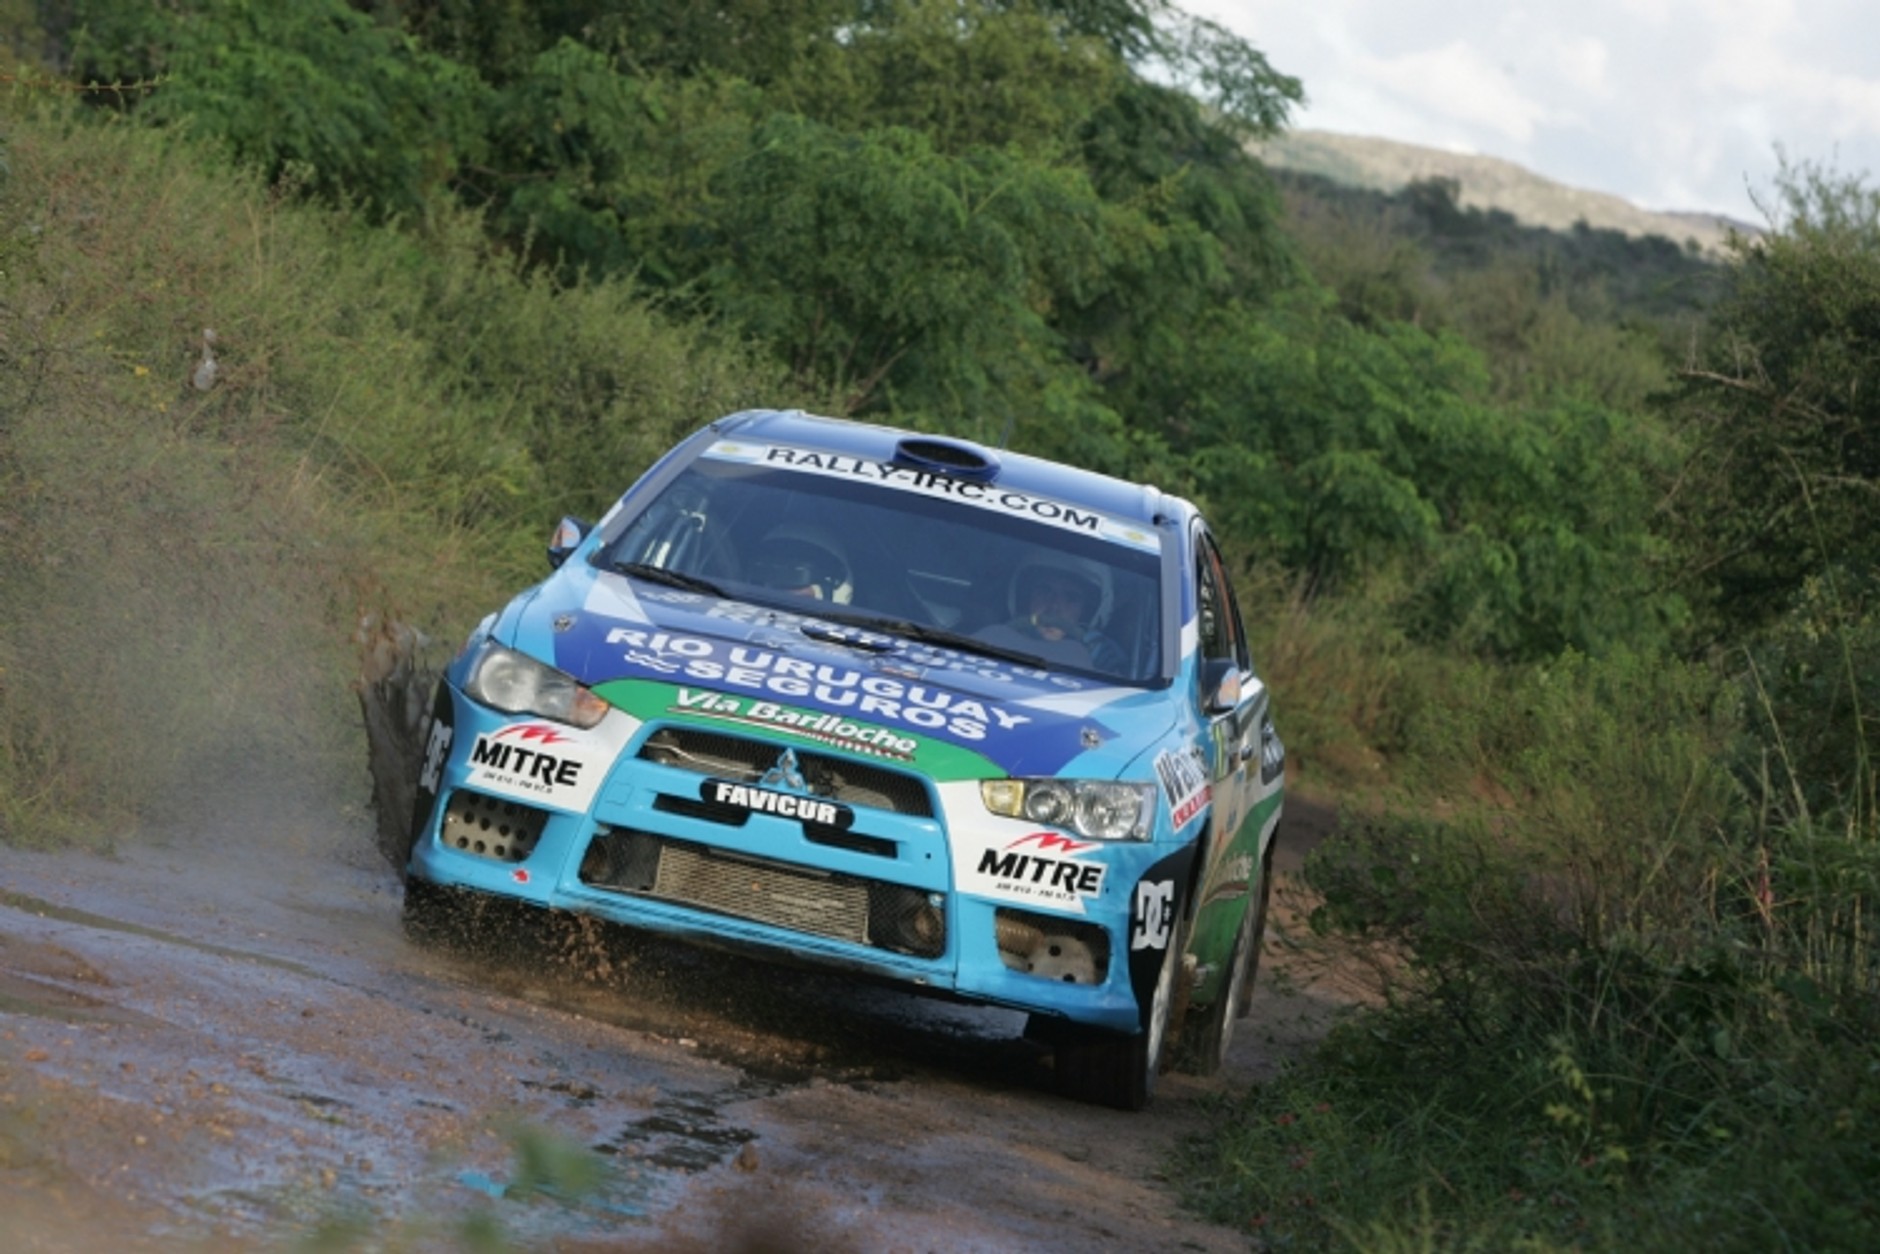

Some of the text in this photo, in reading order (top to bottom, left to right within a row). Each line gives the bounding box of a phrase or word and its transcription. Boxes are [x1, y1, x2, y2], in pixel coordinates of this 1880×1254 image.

[766, 447, 1101, 531] RALLY-IRC.COM
[605, 626, 714, 657] RIO
[729, 647, 1032, 731] URUGUAY
[684, 660, 988, 741] SEGUROS
[677, 688, 741, 712] Via
[747, 701, 917, 752] Bariloche
[471, 738, 583, 787] MITRE
[715, 782, 837, 825] FAVICUR
[977, 848, 1102, 894] MITRE
